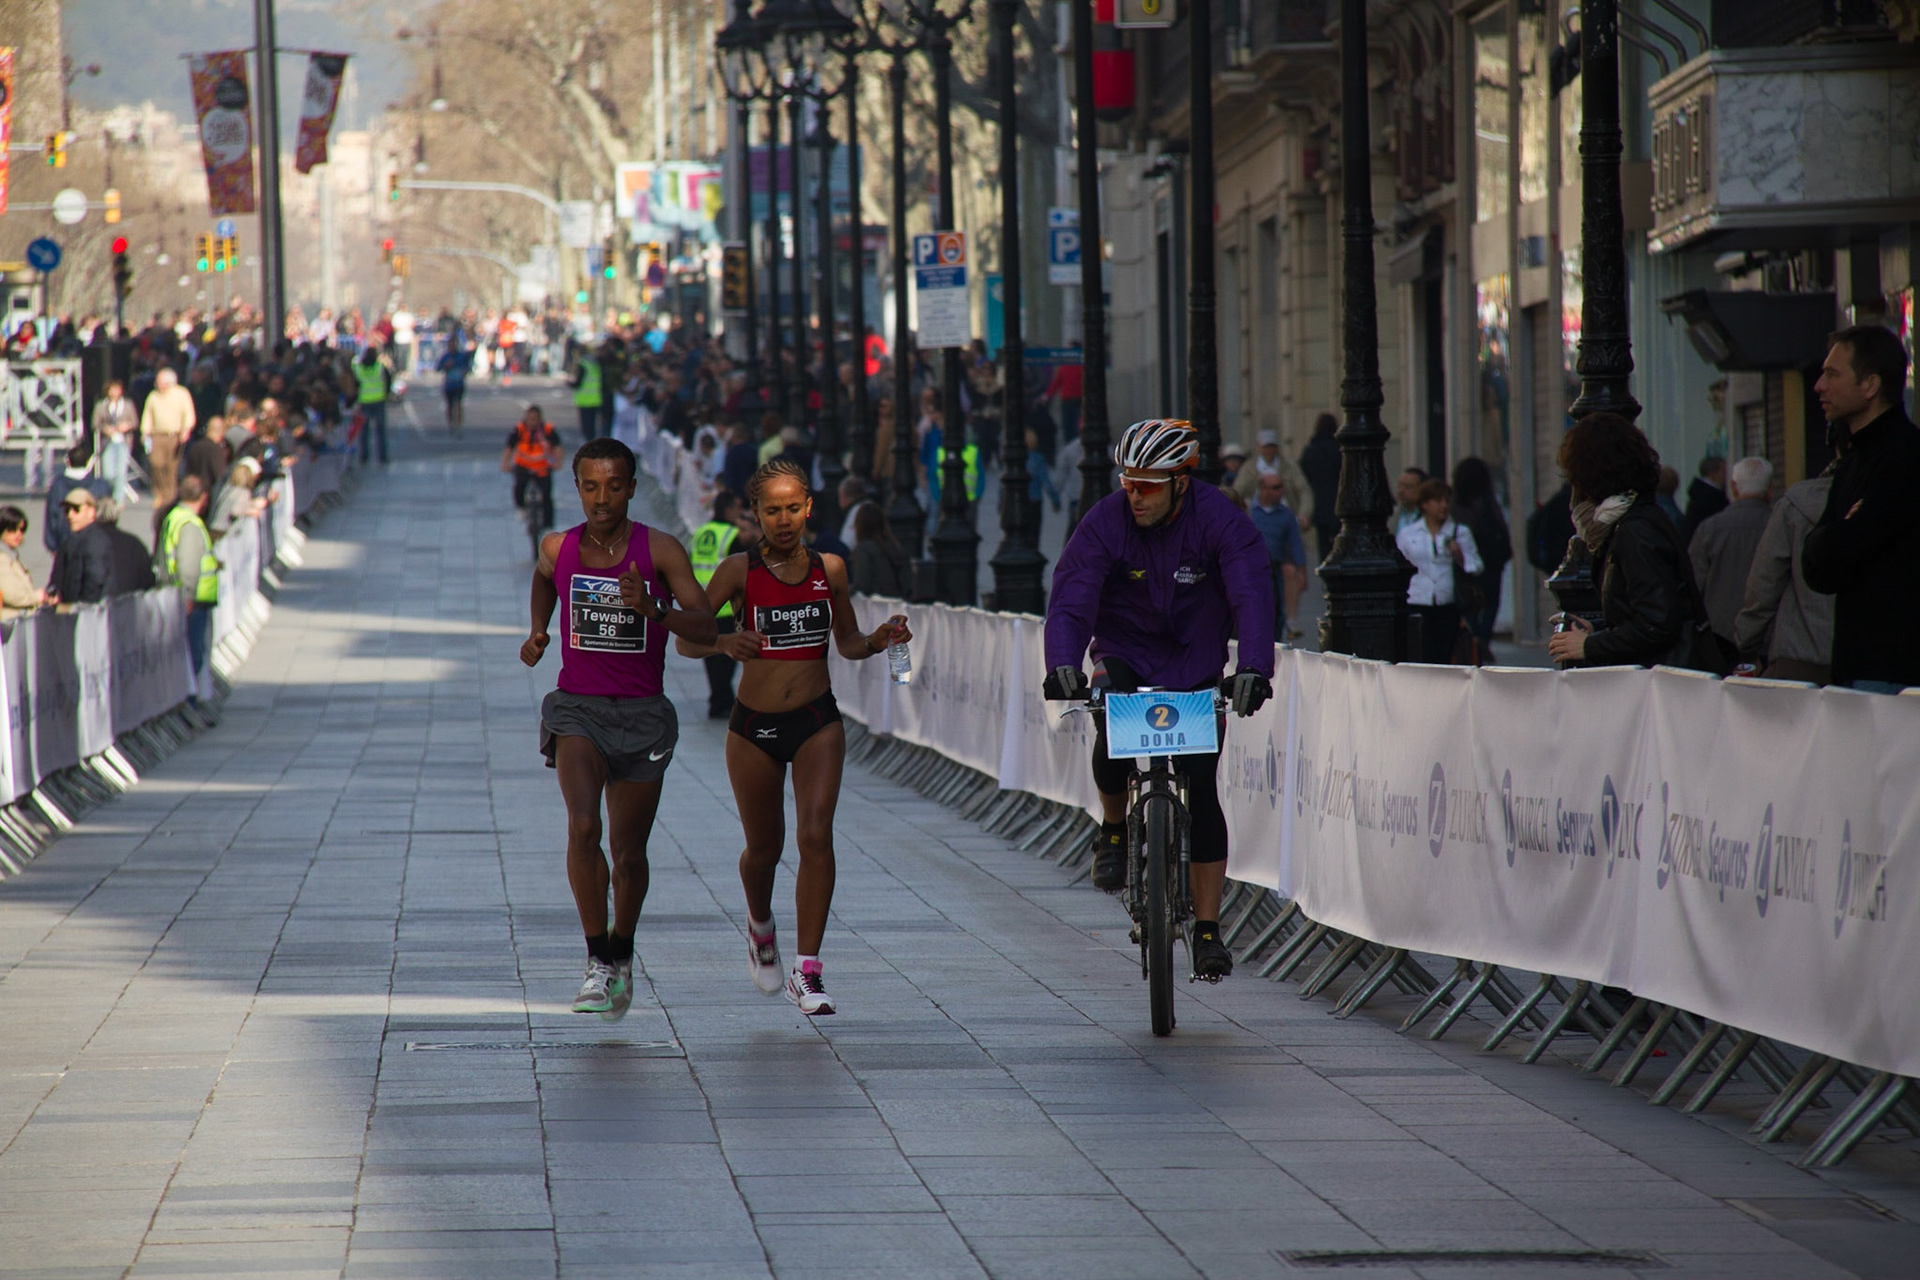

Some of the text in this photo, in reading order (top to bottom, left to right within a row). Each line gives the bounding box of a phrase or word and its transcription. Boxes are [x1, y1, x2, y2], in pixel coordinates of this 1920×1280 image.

[918, 237, 935, 265] P
[582, 608, 635, 624] Tewabe
[771, 605, 820, 622] Degefa
[599, 624, 617, 637] 56
[789, 621, 806, 633] 31
[1154, 706, 1169, 727] 2
[1140, 732, 1186, 747] DONA
[1381, 780, 1418, 849] Seguros
[1514, 796, 1550, 853] ZURICH
[1708, 820, 1749, 903] Seguros
